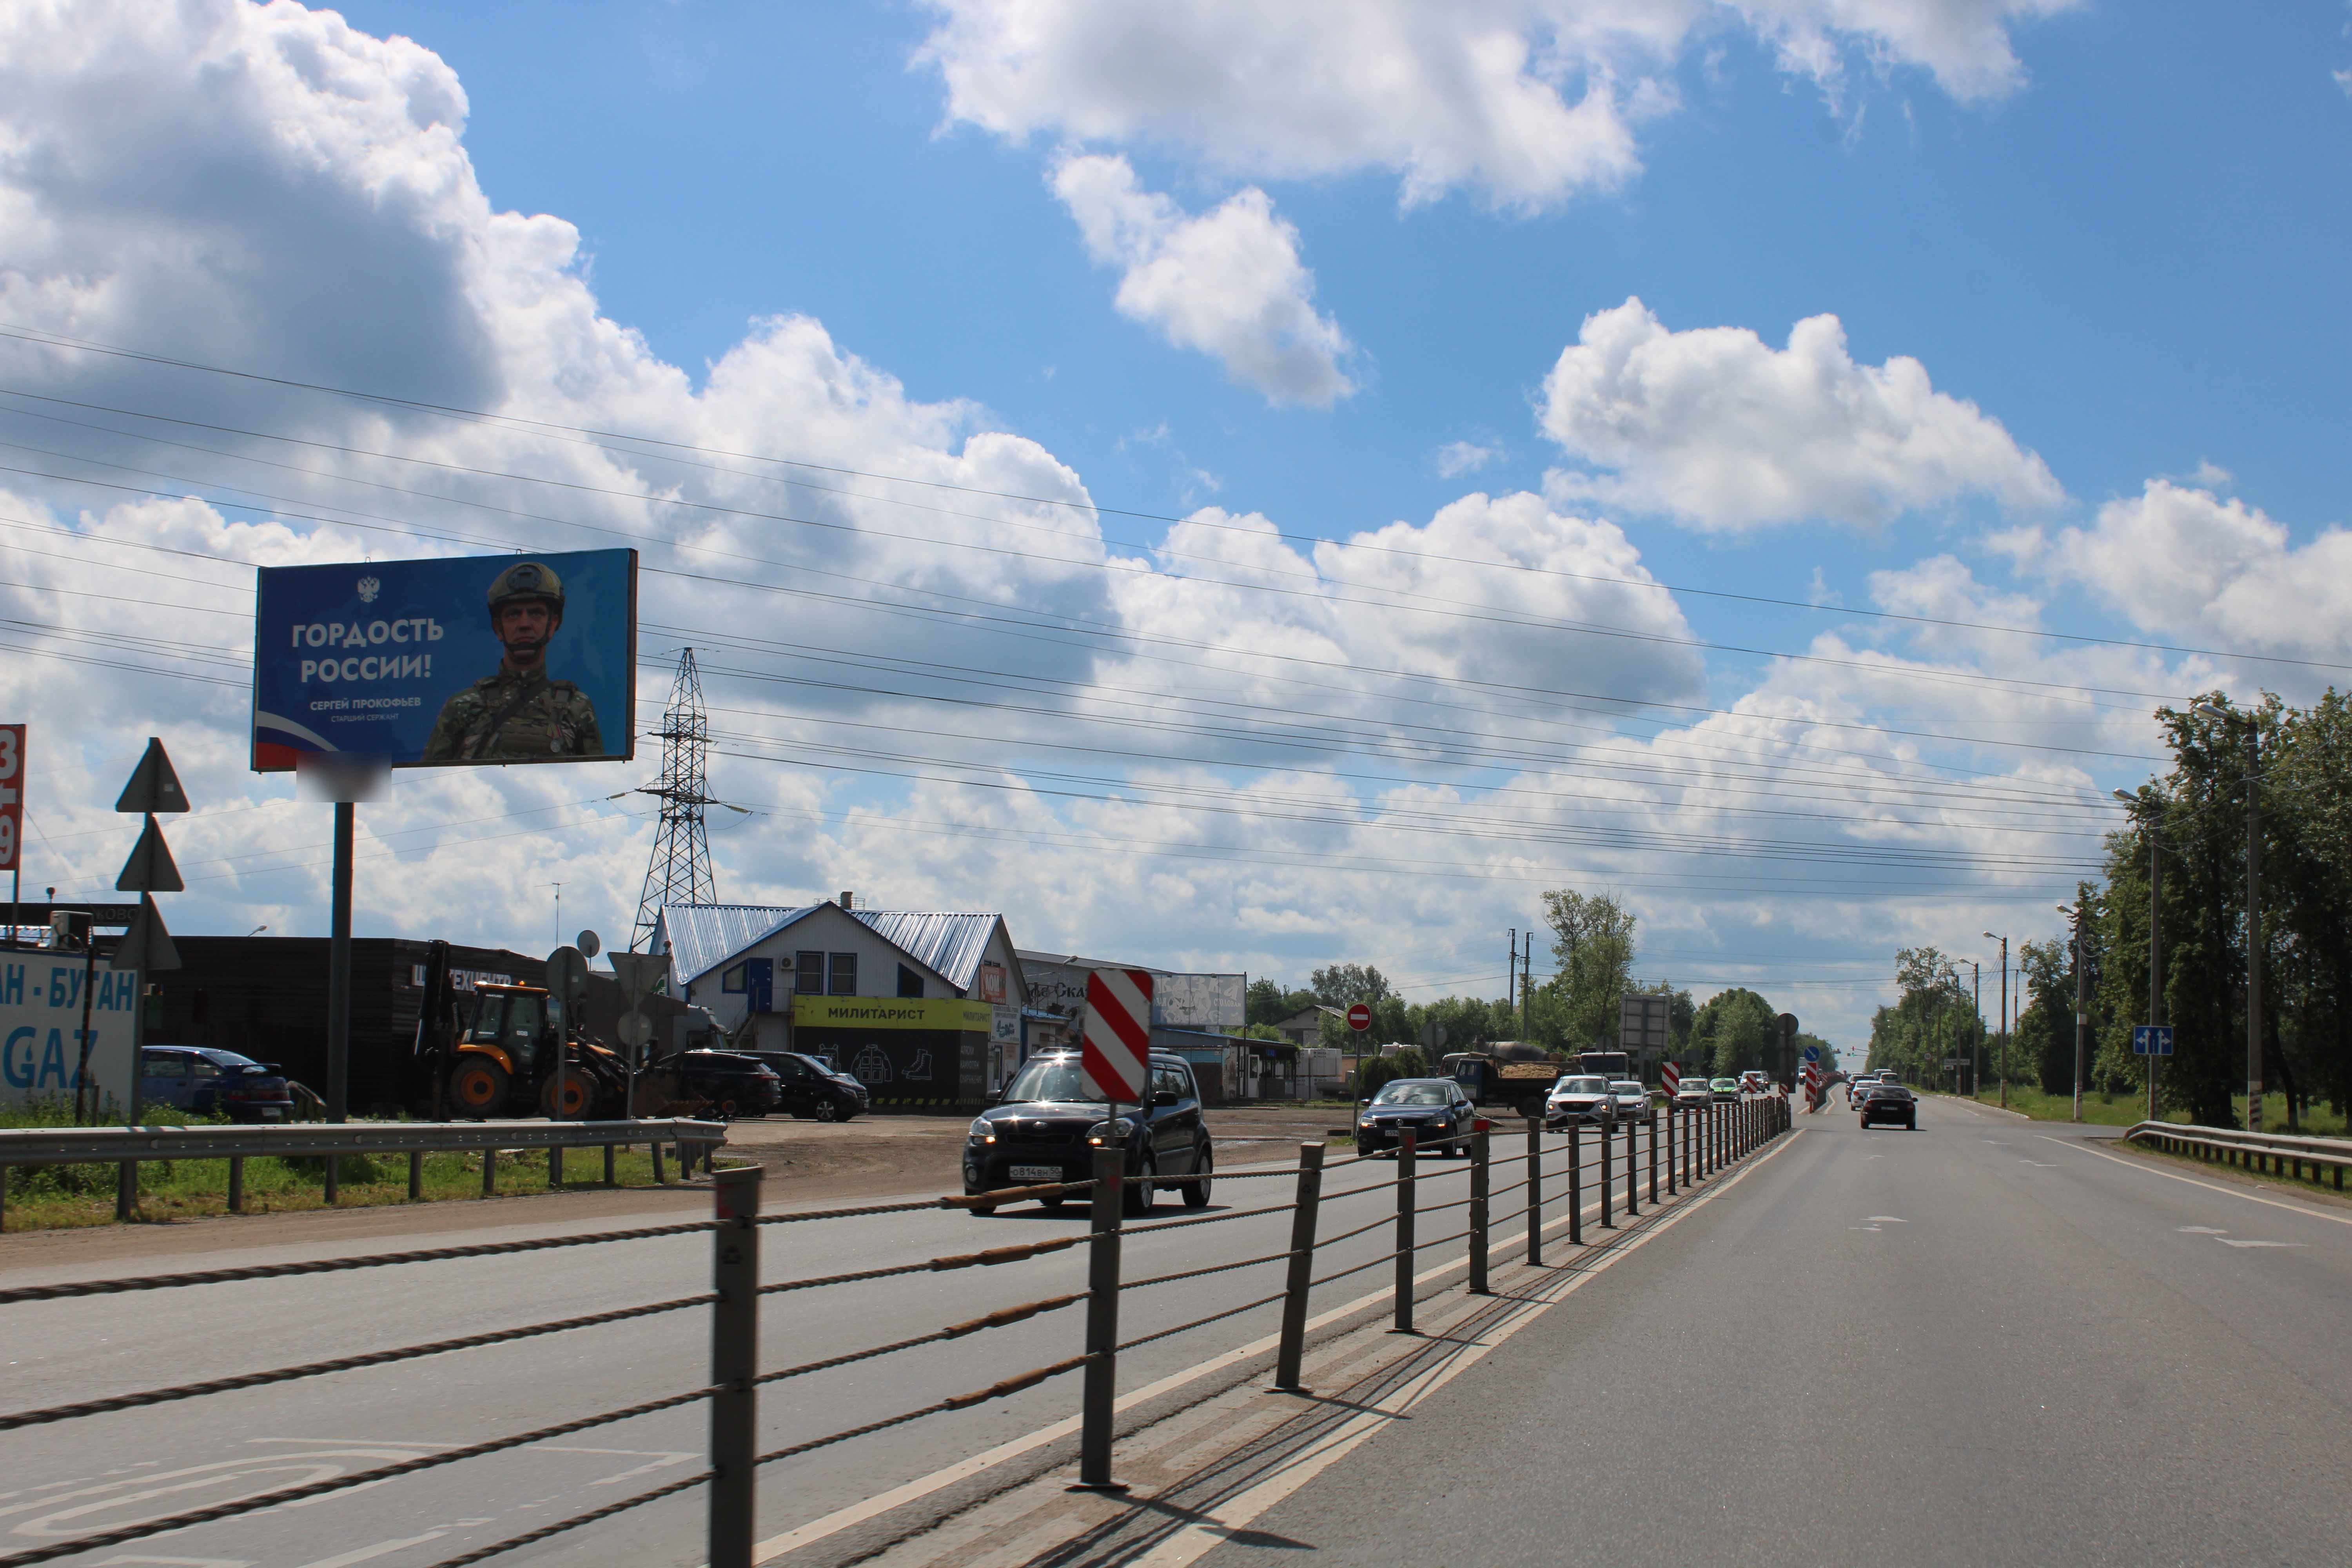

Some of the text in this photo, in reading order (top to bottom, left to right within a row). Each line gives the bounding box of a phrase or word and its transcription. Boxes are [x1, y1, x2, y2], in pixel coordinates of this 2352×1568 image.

[292, 618, 444, 648] ГОРДОСТЬ
[301, 655, 431, 682] РОССИИ!
[310, 697, 421, 710] СЕРГЕЙ ПРОКОФЬЕВ
[331, 713, 365, 722] СТАРШИЙ
[828, 1008, 925, 1020] МИЛИТАРИСТ
[963, 1011, 990, 1022] МИЛИТАРИСТ
